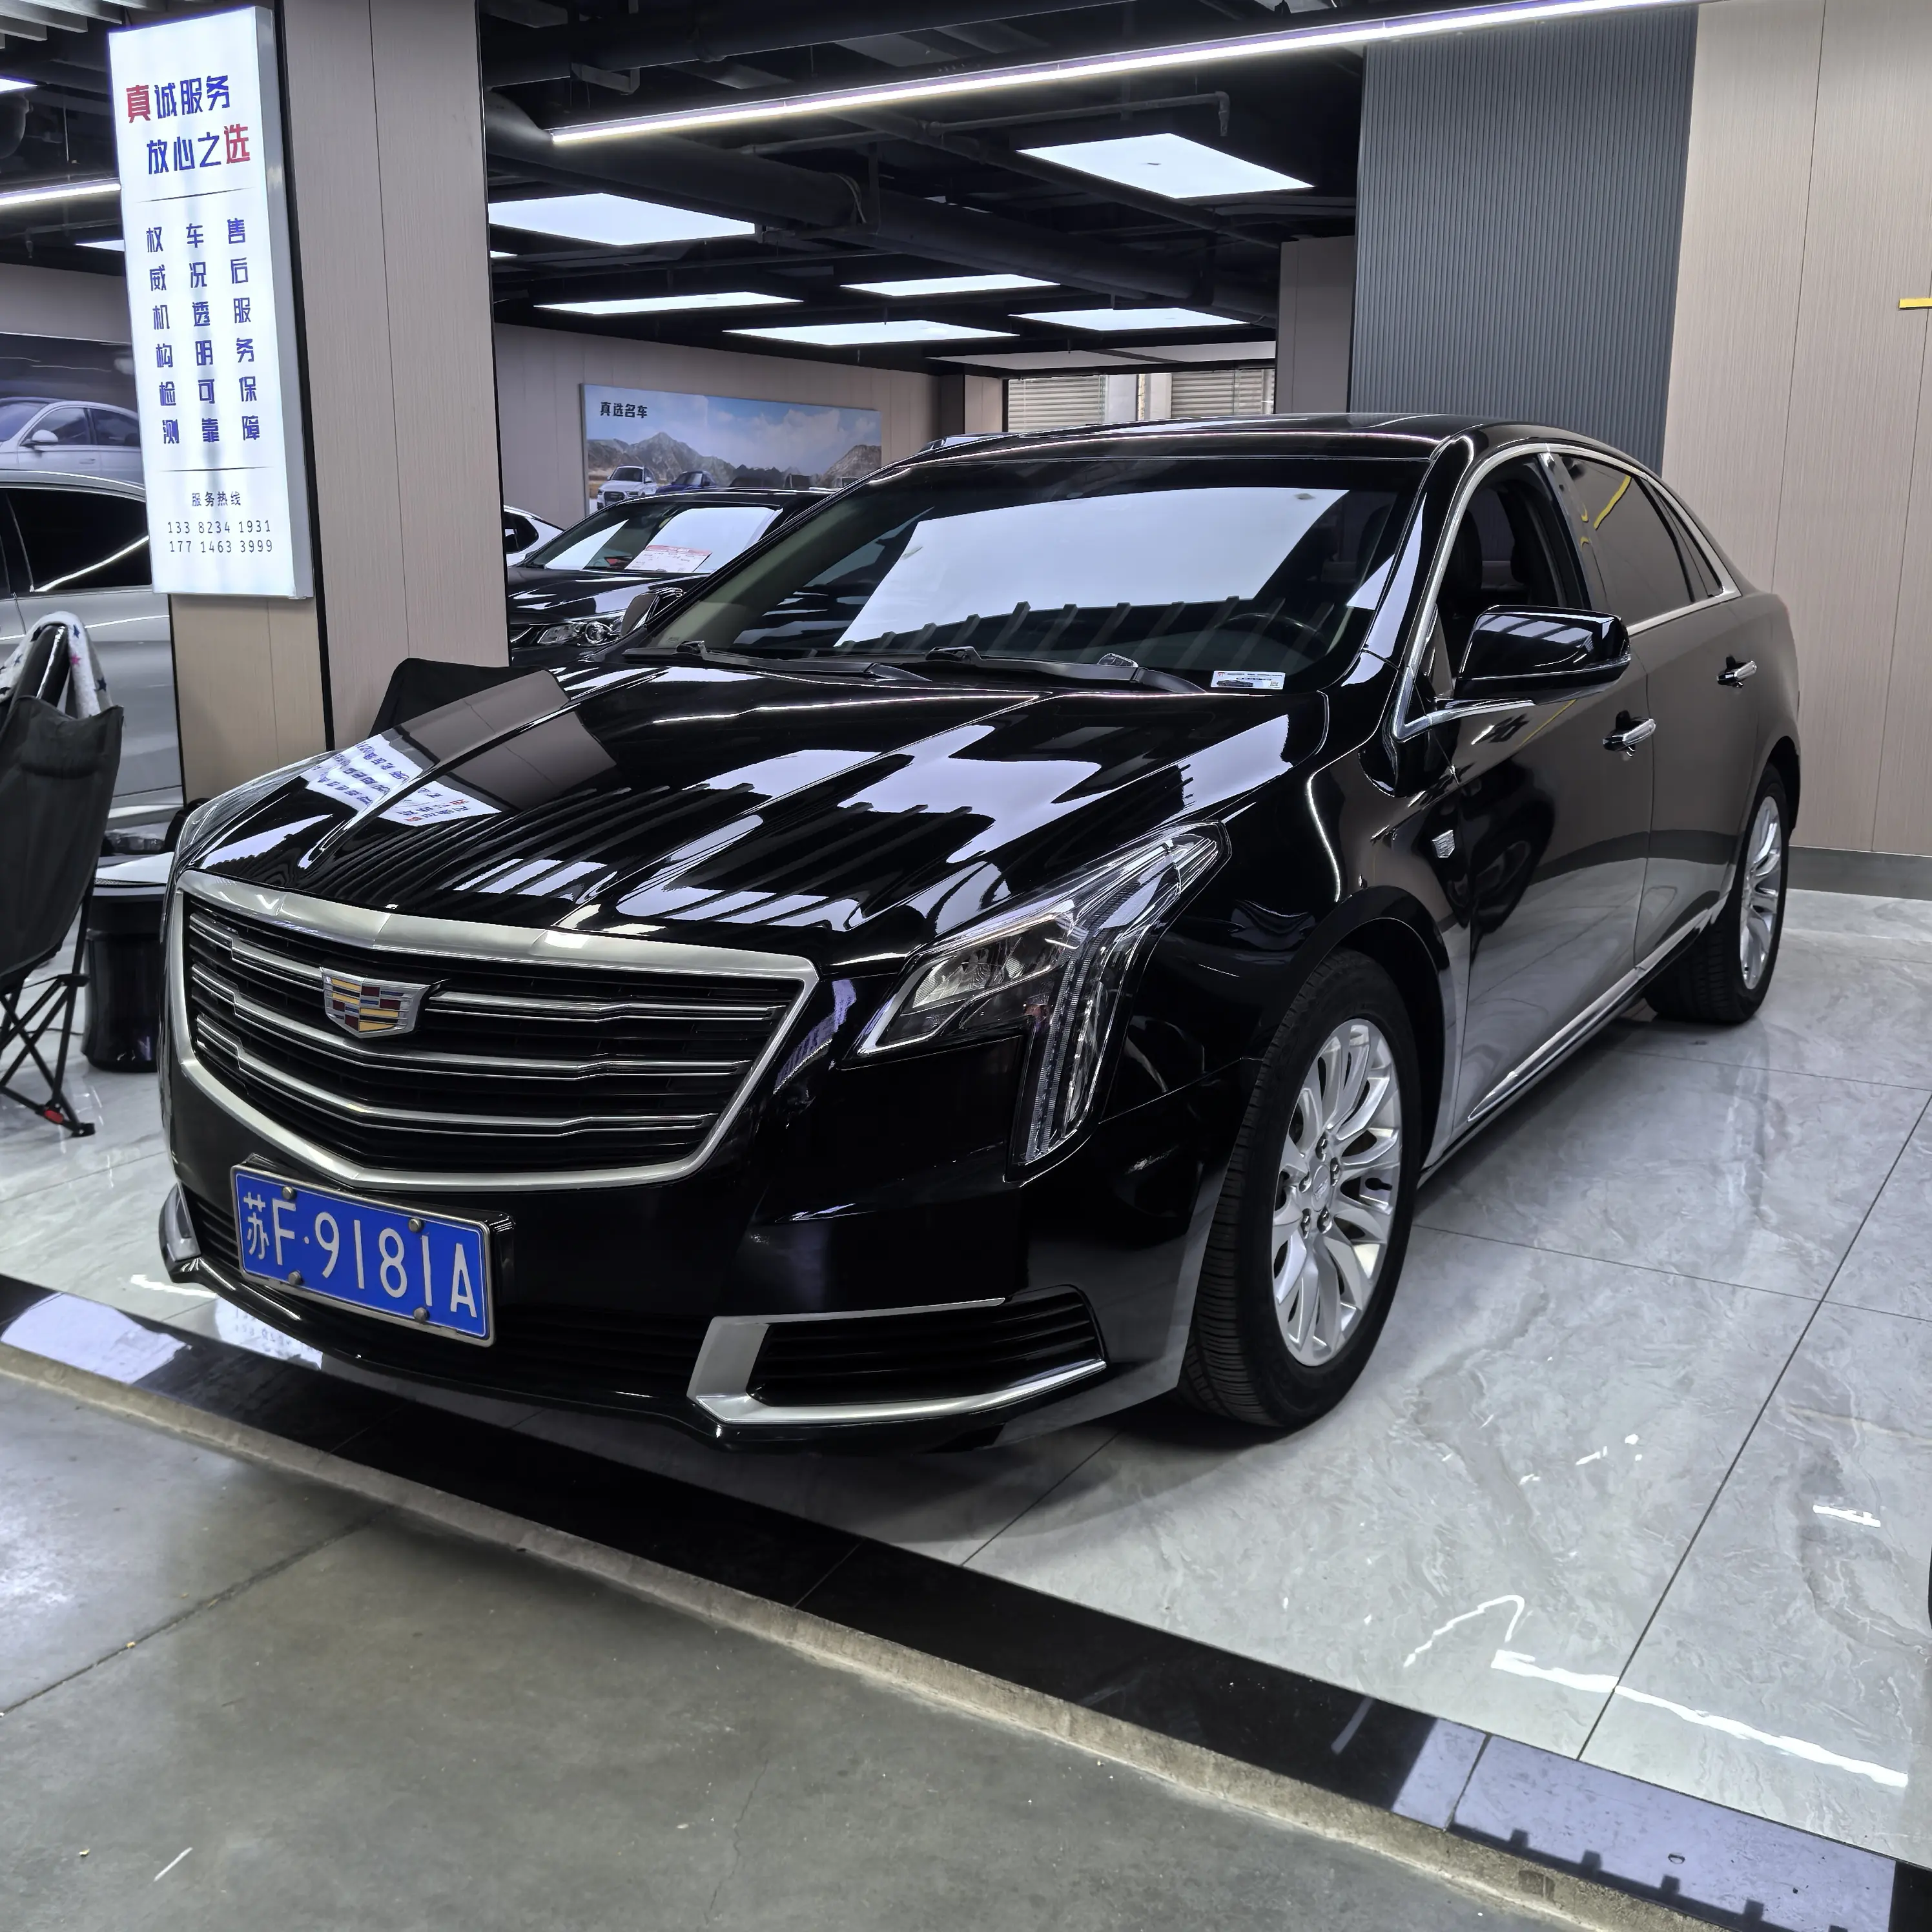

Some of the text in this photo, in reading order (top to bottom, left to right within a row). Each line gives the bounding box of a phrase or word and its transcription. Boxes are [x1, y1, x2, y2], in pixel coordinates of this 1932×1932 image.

[125, 74, 231, 124] 真诚服务
[146, 123, 251, 175] 放心之选
[146, 226, 180, 444] 权威机构检测
[185, 223, 220, 443] 车况透明可靠
[227, 218, 260, 441] 售后服务保障
[600, 401, 648, 418] 真选名车
[192, 491, 242, 507] 服务热线
[167, 519, 271, 534] 133 8234 1931
[169, 539, 272, 553] 177 1463 3999
